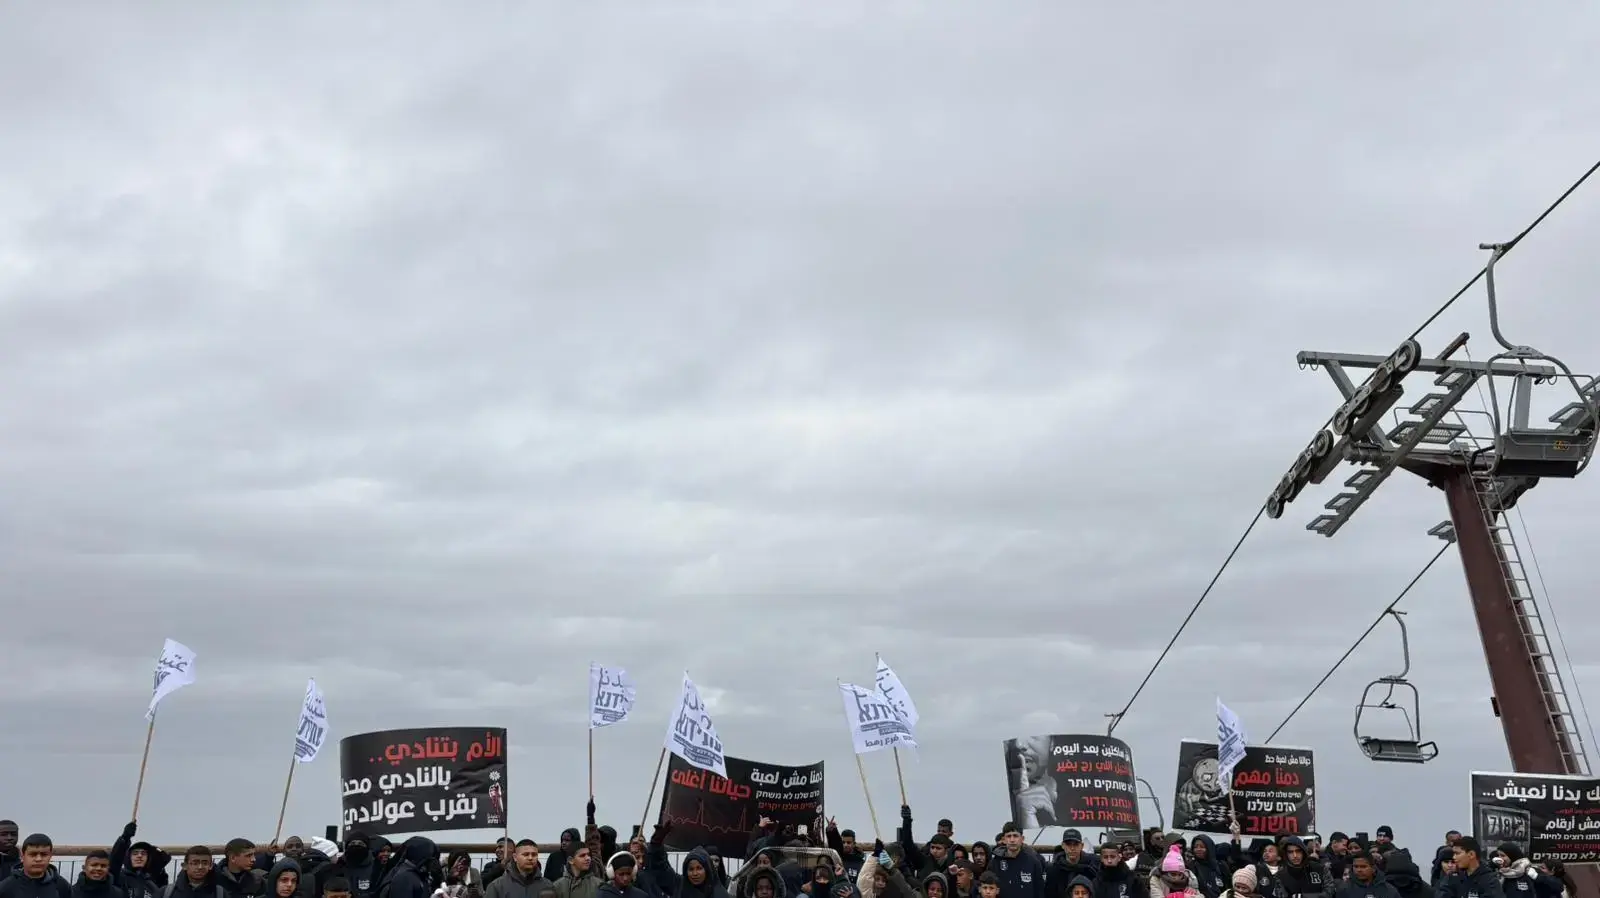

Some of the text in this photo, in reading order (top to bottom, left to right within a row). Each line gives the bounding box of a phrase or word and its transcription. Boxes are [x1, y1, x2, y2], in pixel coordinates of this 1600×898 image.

[369, 732, 501, 765] الأم بتنادي..
[1053, 742, 1080, 756] اليوم
[1083, 744, 1099, 757] بعد
[379, 766, 451, 794] بالنادي
[751, 768, 780, 786] لعبة
[783, 770, 808, 788] مش
[1068, 779, 1091, 788] יותר
[1234, 767, 1300, 788] دمنا مهم
[709, 775, 752, 800] حياتنا
[1094, 779, 1127, 792] שותקים
[1482, 779, 1547, 802] نعيش...
[756, 790, 782, 800] משחק
[1081, 796, 1109, 807] הדור
[1552, 785, 1581, 805] بدنا
[424, 793, 477, 821] بقرب
[1247, 799, 1296, 812] הדם שלנו
[344, 799, 415, 830] عولادي
[1070, 808, 1095, 820] הכל
[1098, 810, 1114, 821] את
[1246, 815, 1298, 833] חשוב
[1546, 815, 1600, 831] مش أرقام
[1533, 851, 1596, 861] לא מספרים
[1310, 872, 1321, 884] R
